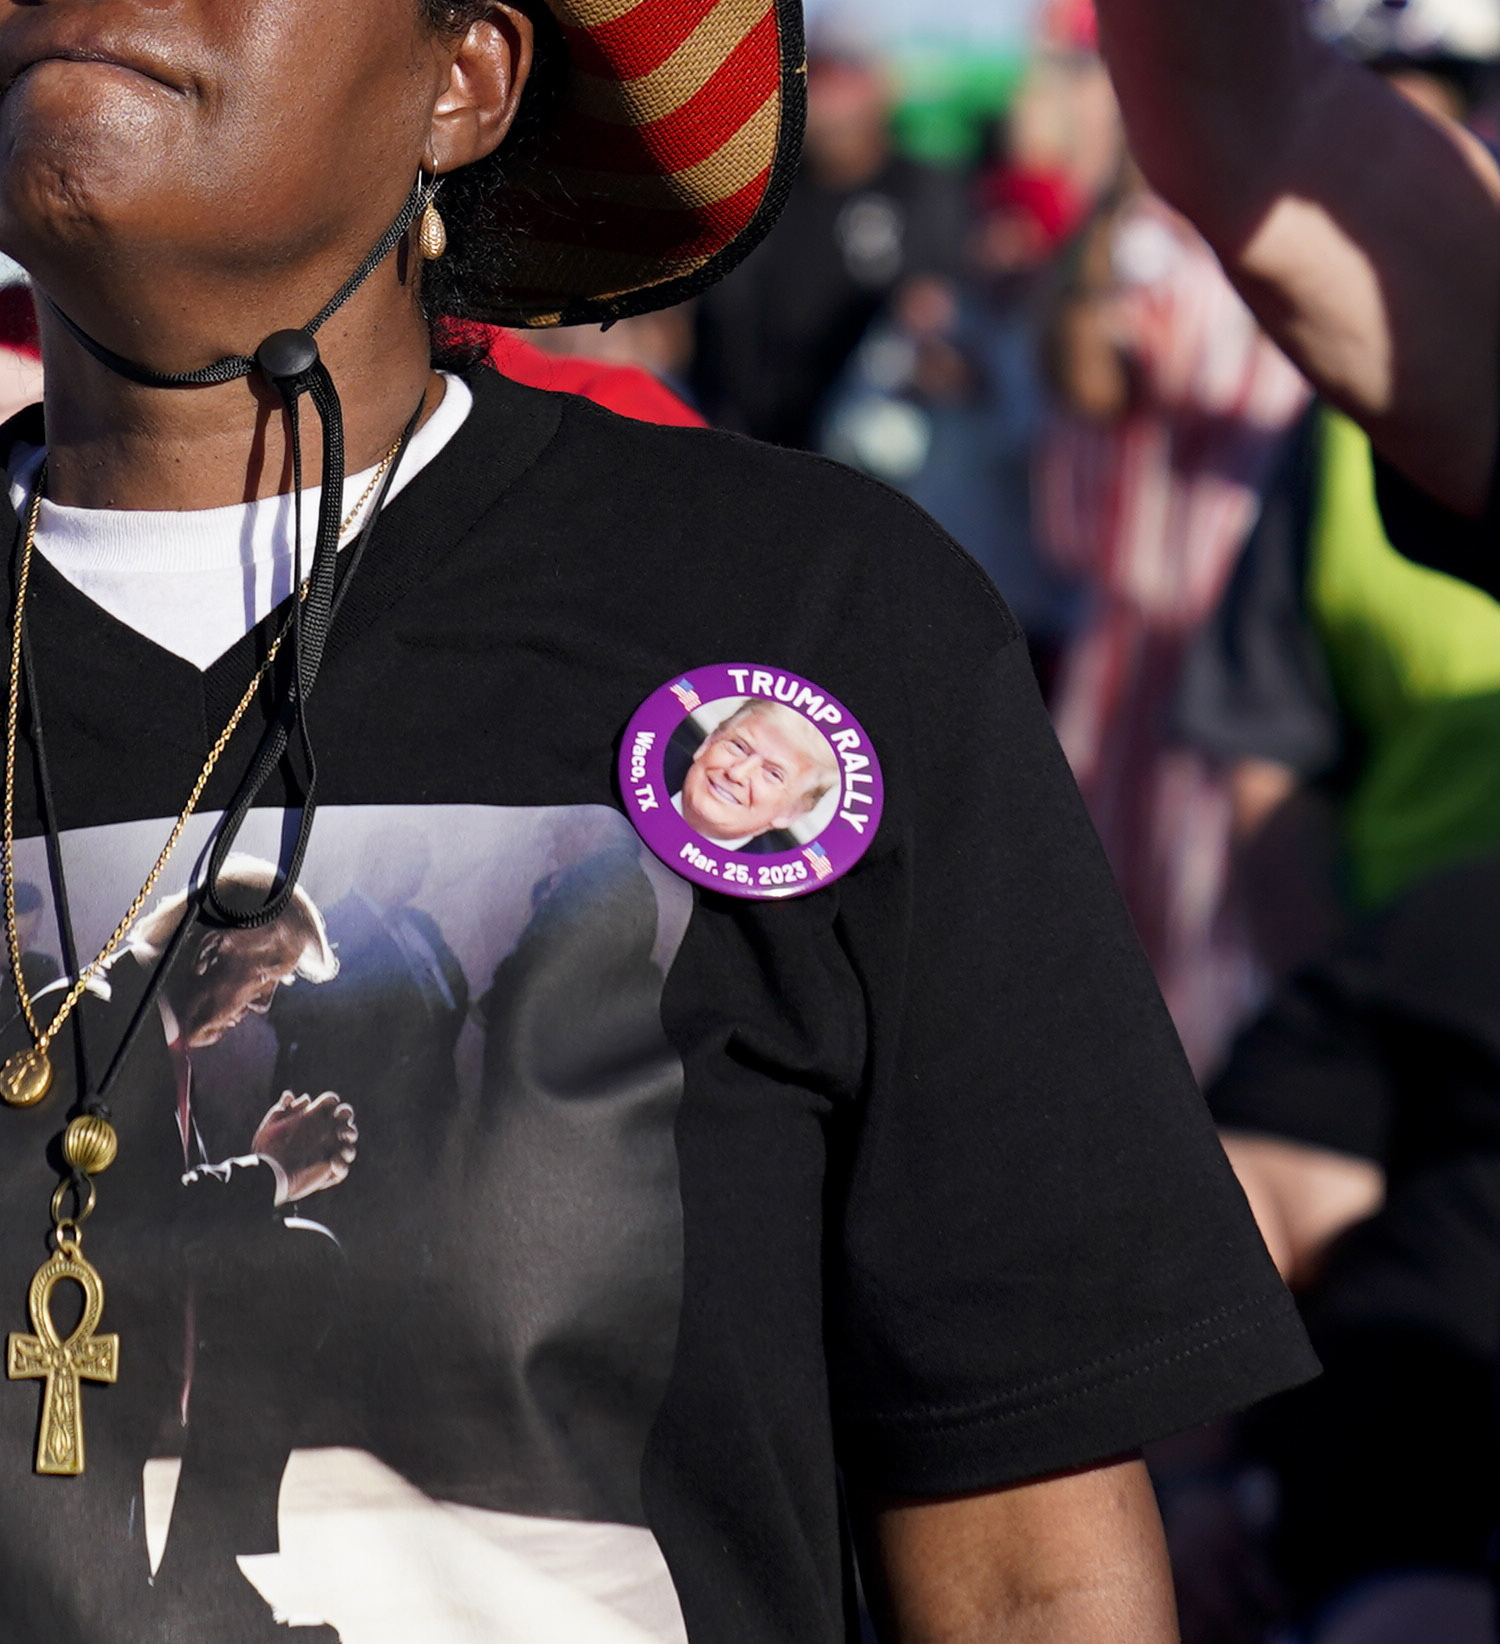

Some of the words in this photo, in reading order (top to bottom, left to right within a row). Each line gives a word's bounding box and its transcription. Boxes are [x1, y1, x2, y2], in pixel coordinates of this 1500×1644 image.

[629, 730, 656, 785] Waco,
[727, 668, 843, 726] TRUMP
[830, 727, 875, 835] RALLY
[636, 782, 661, 813] TX
[679, 841, 720, 877] Mar.
[722, 861, 755, 886] 25,
[757, 859, 808, 886] 2023
